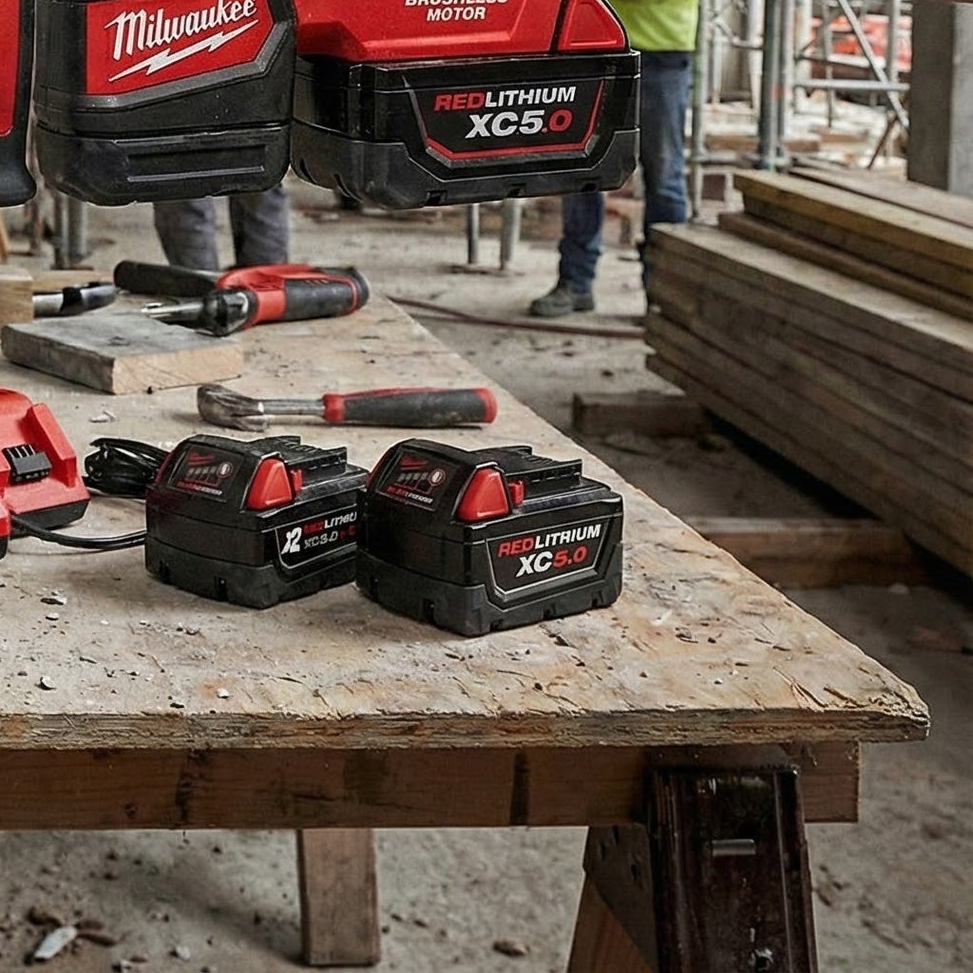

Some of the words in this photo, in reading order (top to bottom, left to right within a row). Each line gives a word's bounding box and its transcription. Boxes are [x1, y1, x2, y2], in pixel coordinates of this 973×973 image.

[427, 7, 486, 21] MOTOR
[434, 86, 576, 111] REDLITHIUM
[465, 109, 573, 139] XC5.0
[516, 546, 588, 578] XC5.0
